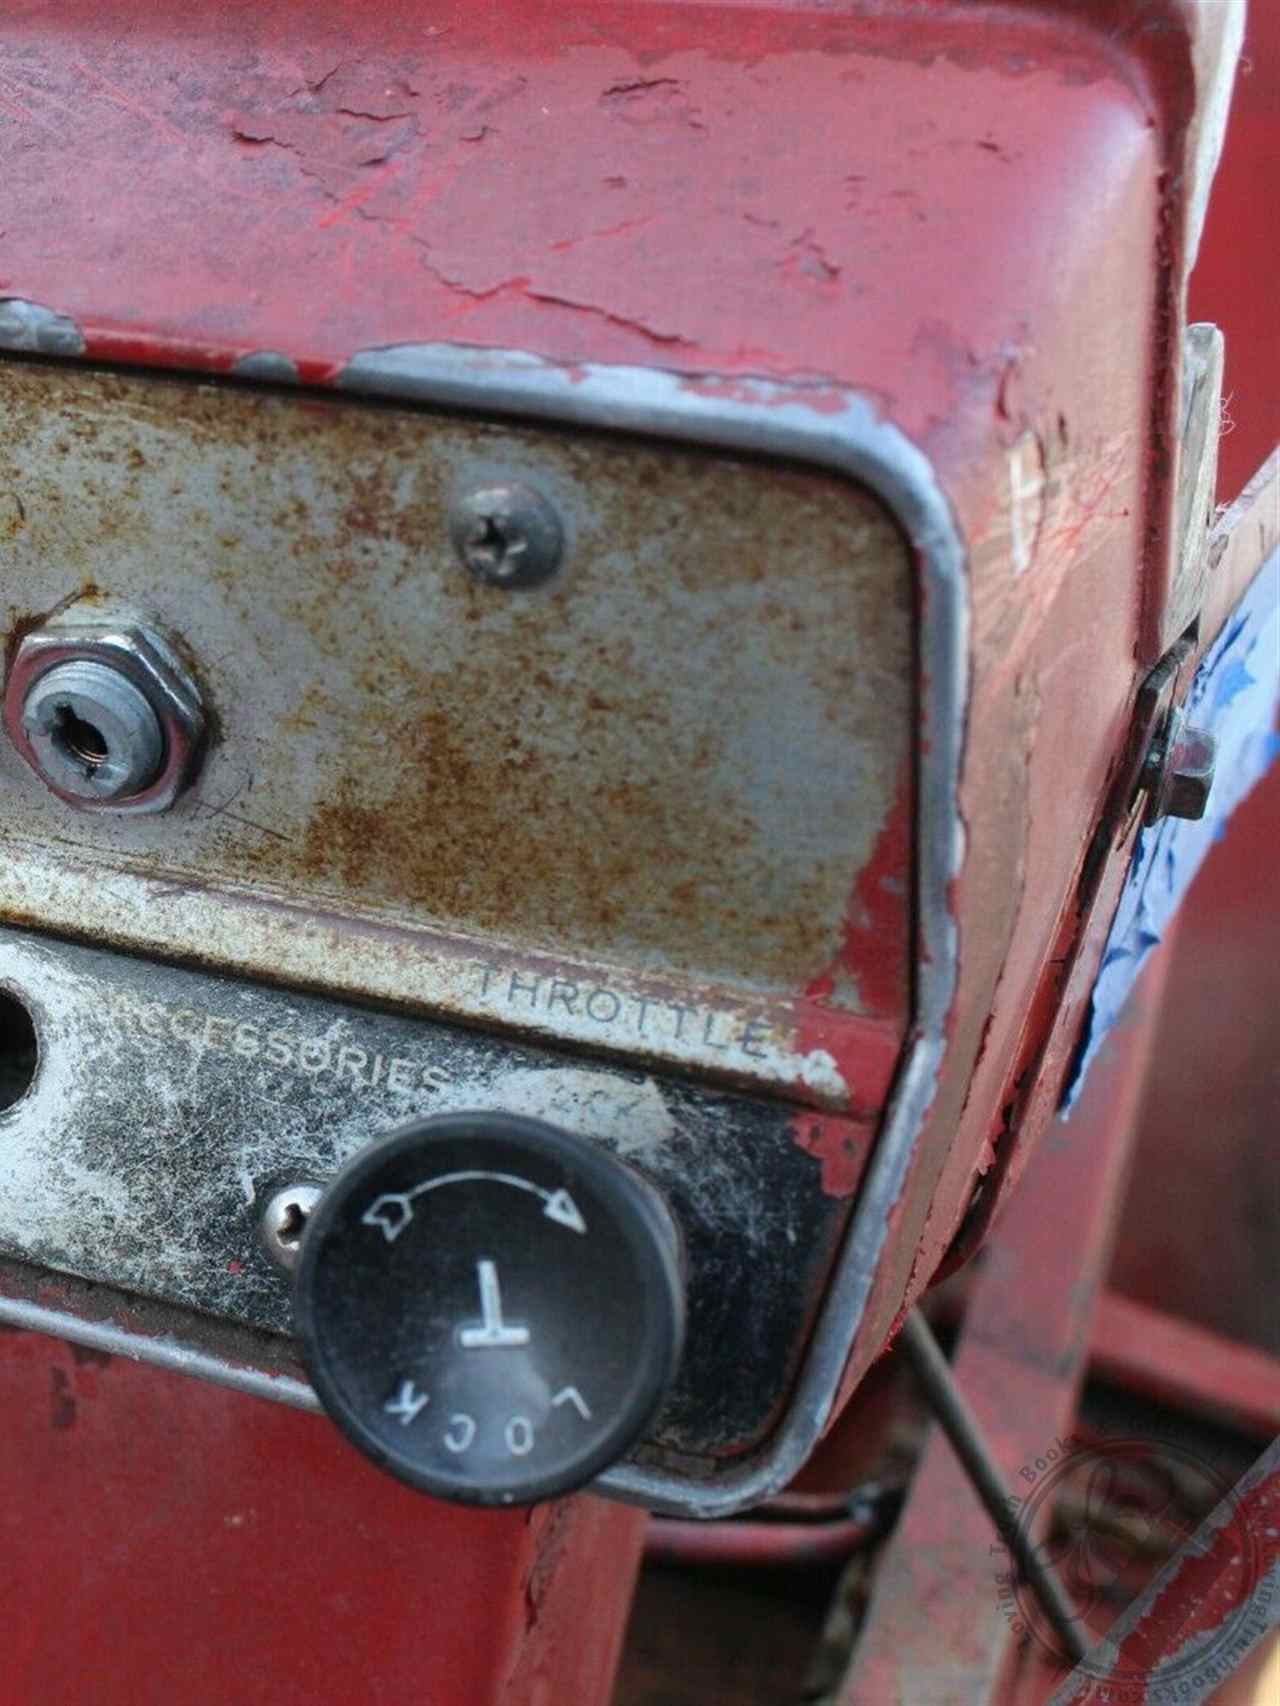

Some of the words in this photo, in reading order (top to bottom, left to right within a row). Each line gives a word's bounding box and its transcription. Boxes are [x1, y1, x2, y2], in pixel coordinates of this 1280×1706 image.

[115, 1000, 453, 1095] CCESSORIES
[473, 962, 775, 1059] THROTTLE
[384, 1380, 592, 1457] LOCK
